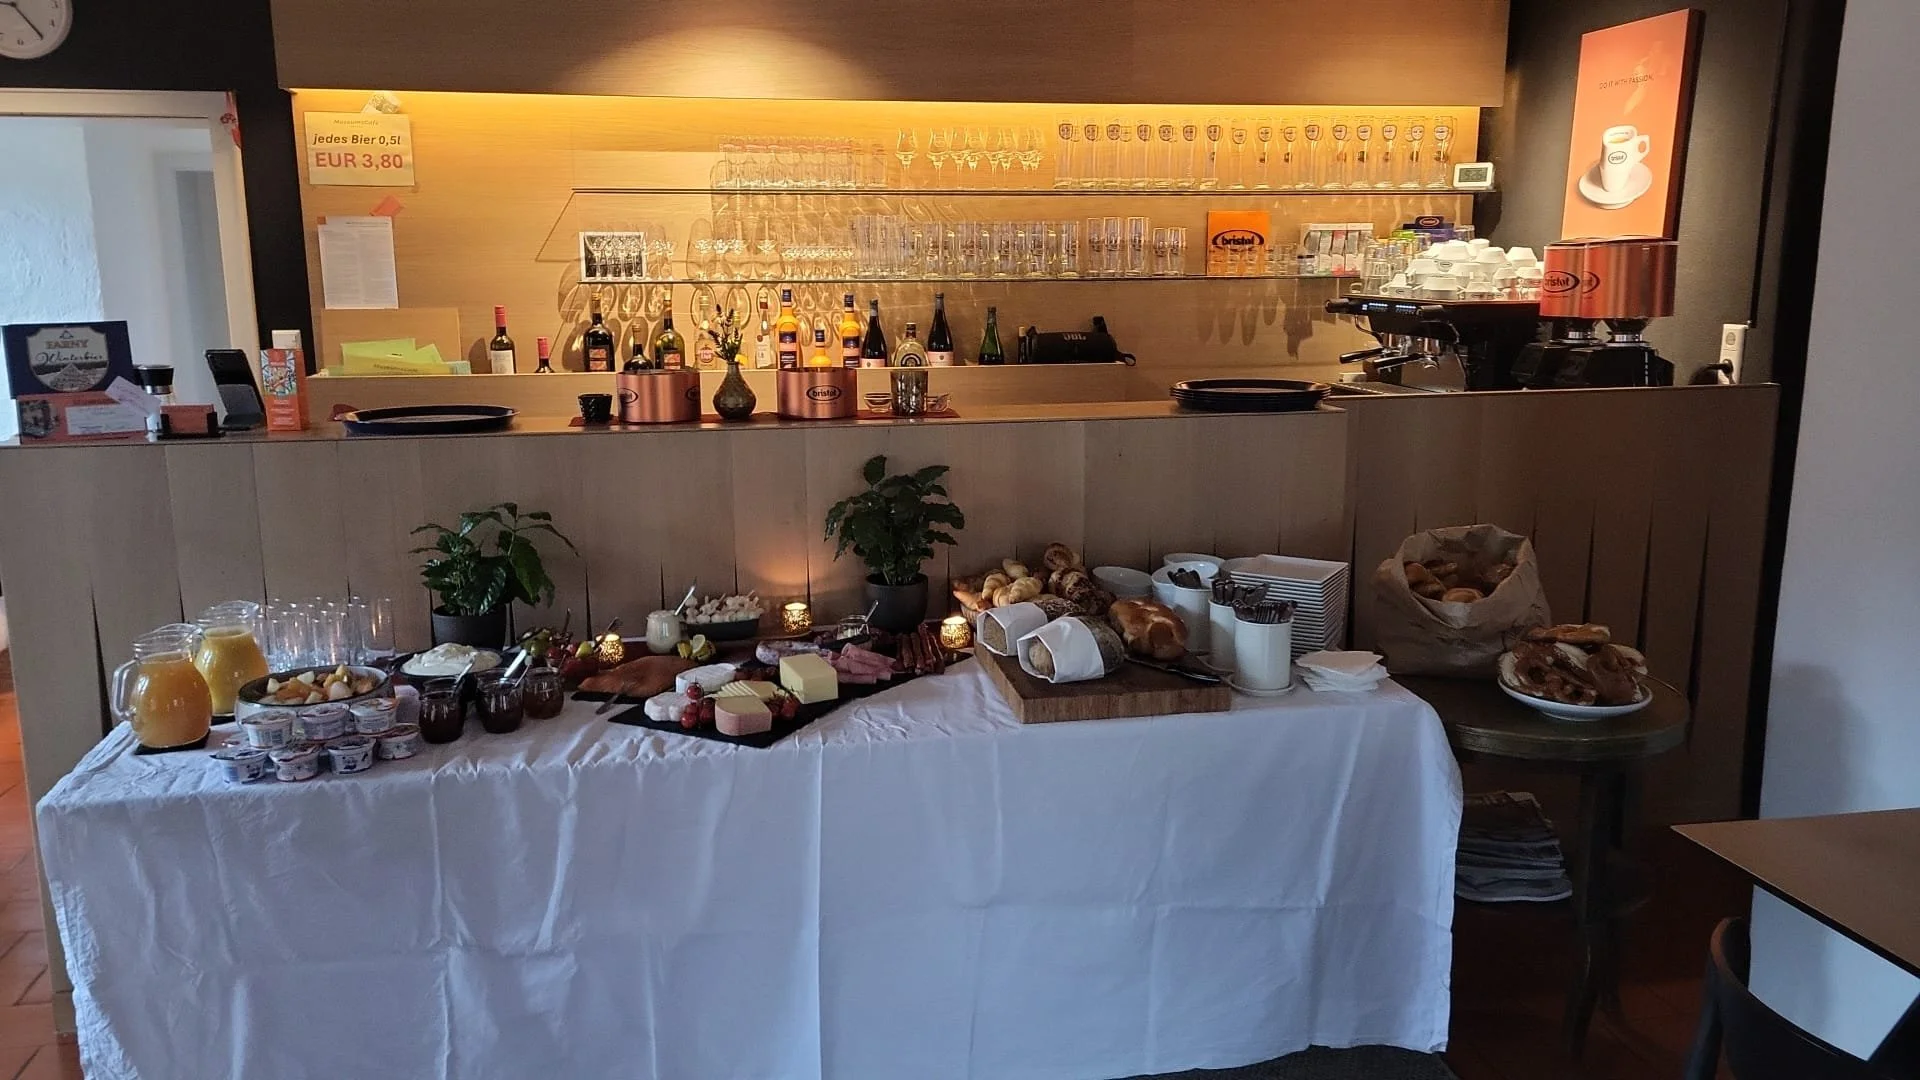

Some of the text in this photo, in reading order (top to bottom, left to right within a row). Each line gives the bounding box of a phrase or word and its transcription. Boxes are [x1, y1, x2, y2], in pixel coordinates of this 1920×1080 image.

[313, 133, 401, 146] jedes Bier 0,5l
[315, 152, 403, 171] EUR 3,80
